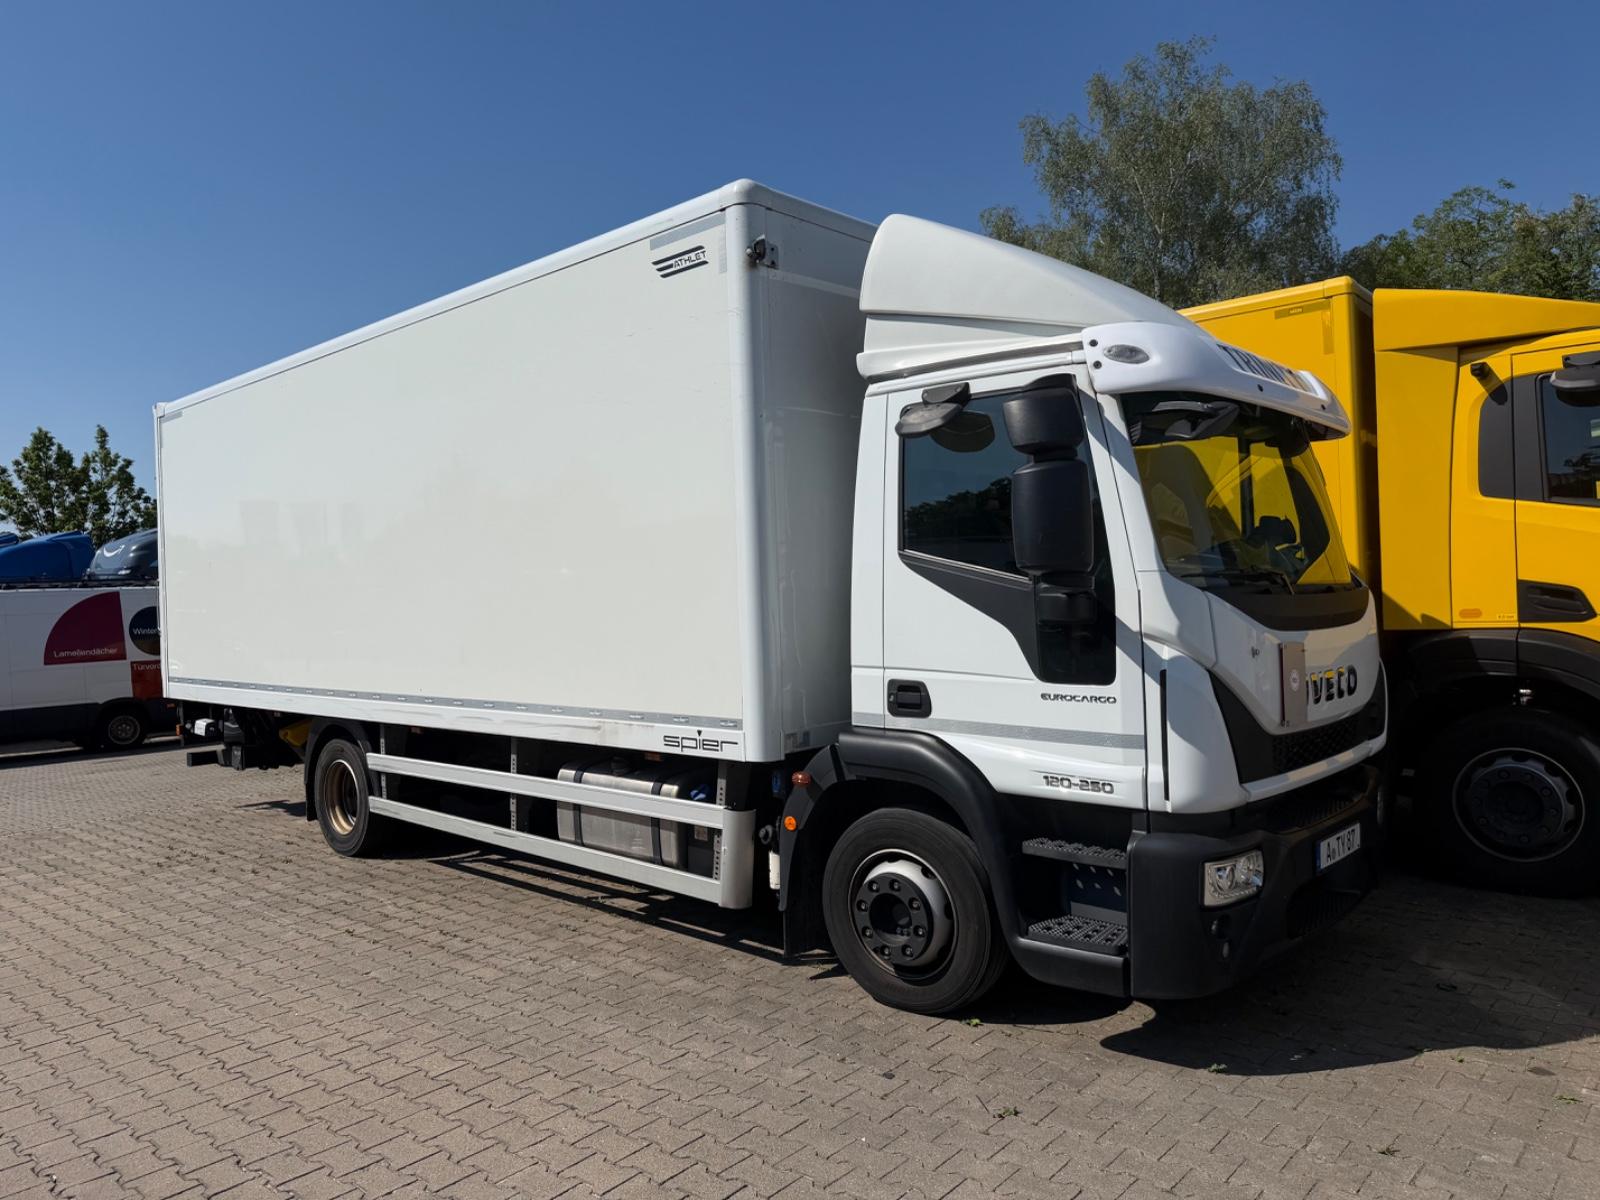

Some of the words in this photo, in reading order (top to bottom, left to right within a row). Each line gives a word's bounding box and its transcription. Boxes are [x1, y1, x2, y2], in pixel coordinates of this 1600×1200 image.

[673, 250, 706, 269] ATHLET
[1040, 692, 1117, 704] EUROCARGO
[663, 729, 739, 752] spier
[1042, 775, 1115, 794] 120-250
